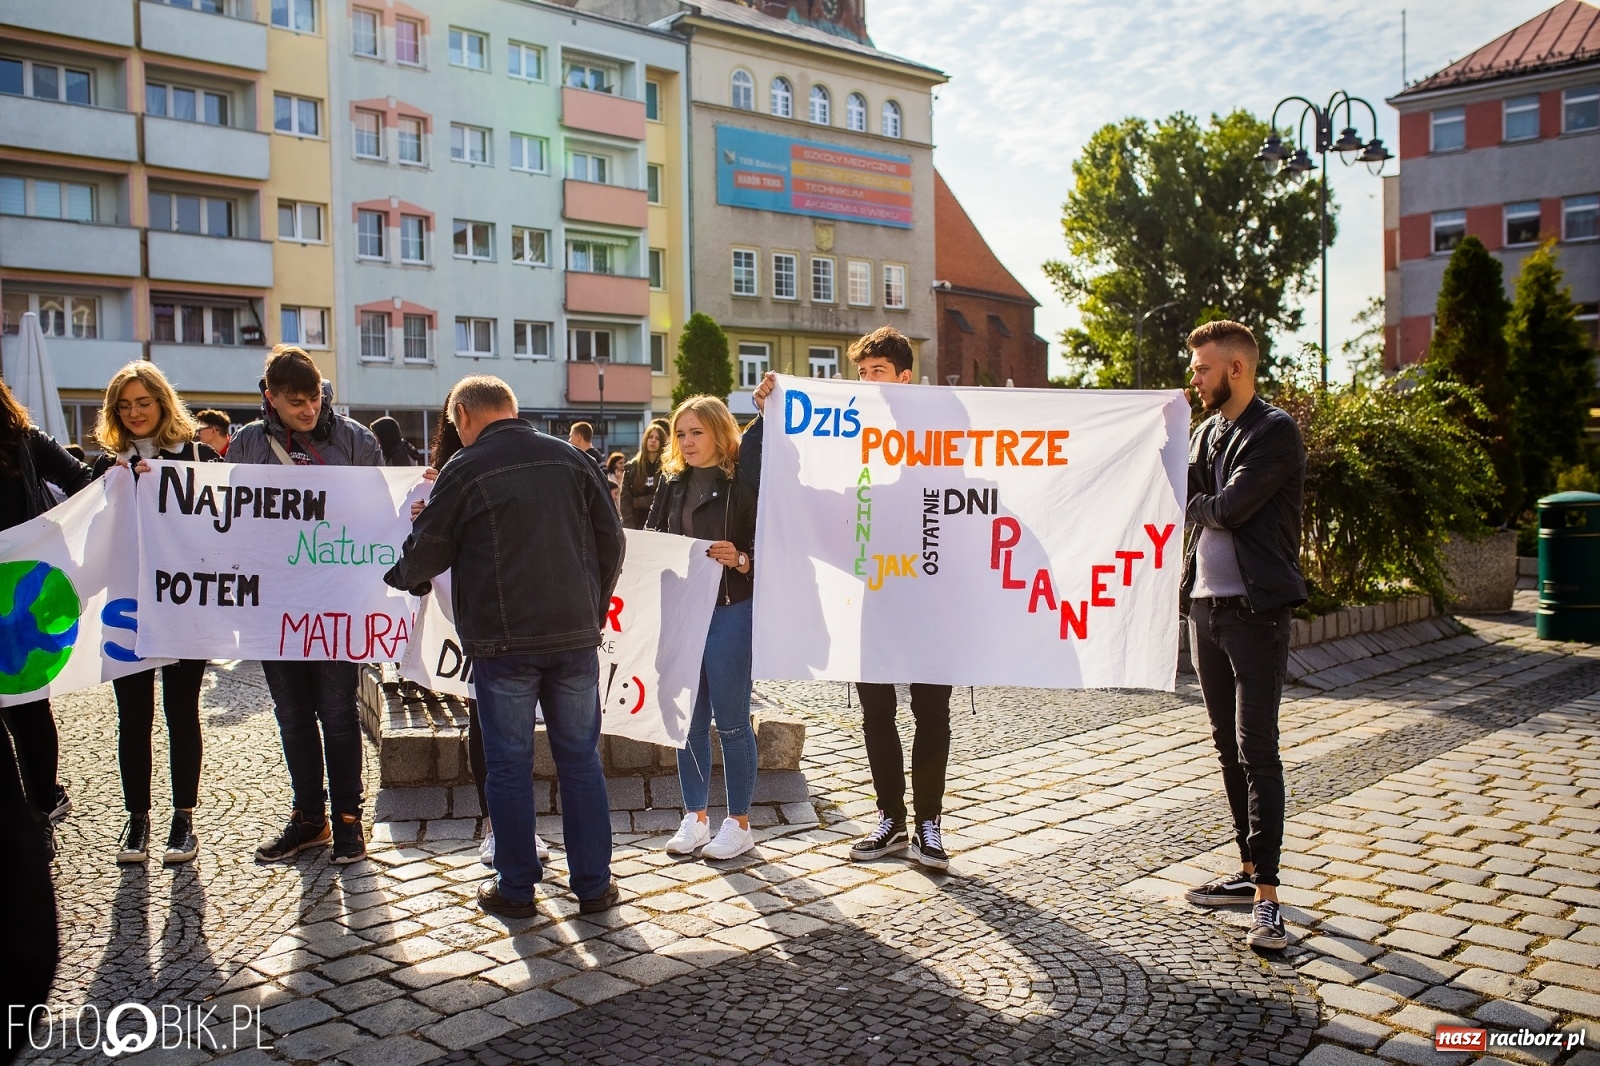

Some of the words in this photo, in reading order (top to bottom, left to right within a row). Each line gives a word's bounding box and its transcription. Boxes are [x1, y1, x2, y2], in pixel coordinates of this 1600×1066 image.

[803, 150, 843, 164] SZKOŁY
[843, 157, 897, 174] MEDYCZNE
[804, 182, 865, 199] TECHNIKUM
[804, 199, 859, 214] AKADEMIA
[861, 427, 1069, 467] POWIETRZE
[158, 466, 327, 533] NAJPIERW
[288, 521, 396, 567] Natura
[922, 488, 940, 576] OSTATNIE
[944, 488, 998, 515] DNI
[155, 570, 260, 607] POTEM
[868, 554, 919, 591] JAK
[990, 516, 1175, 640] PLANETY
